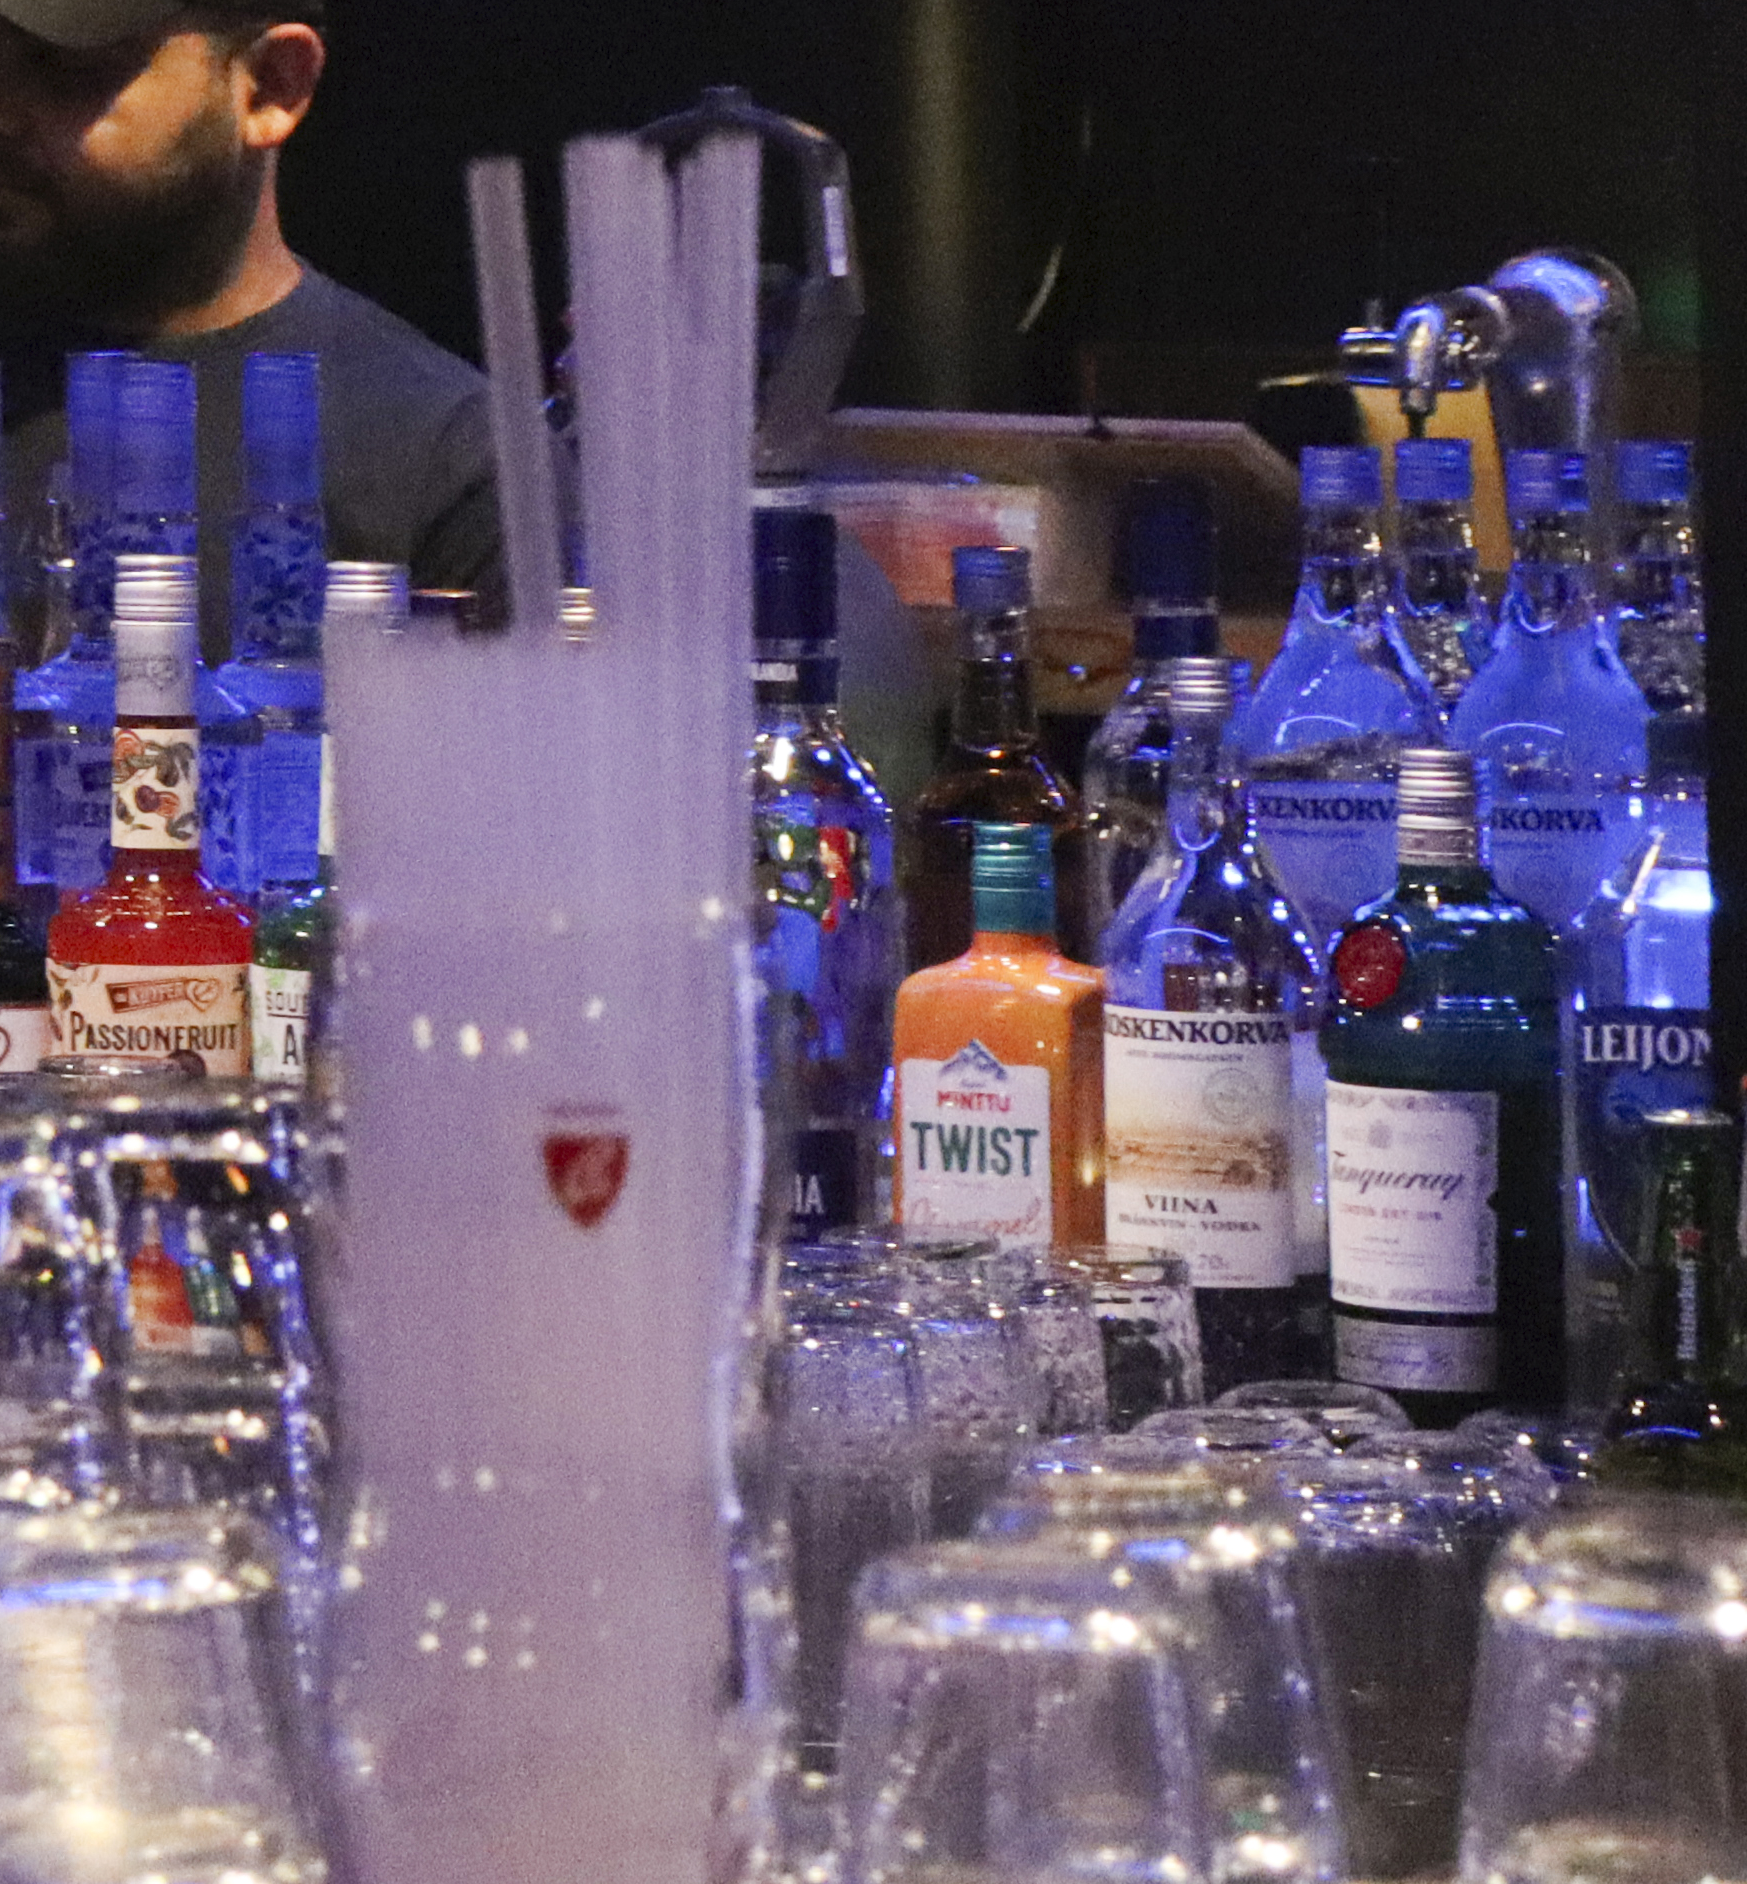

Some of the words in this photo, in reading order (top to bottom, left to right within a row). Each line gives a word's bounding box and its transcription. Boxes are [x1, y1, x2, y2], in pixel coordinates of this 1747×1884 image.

[69, 1009, 237, 1057] PASSIONFRUIT
[936, 1088, 1012, 1114] MINTTU
[908, 1120, 1040, 1178] TWIST
[1144, 1193, 1219, 1216] VIINA
